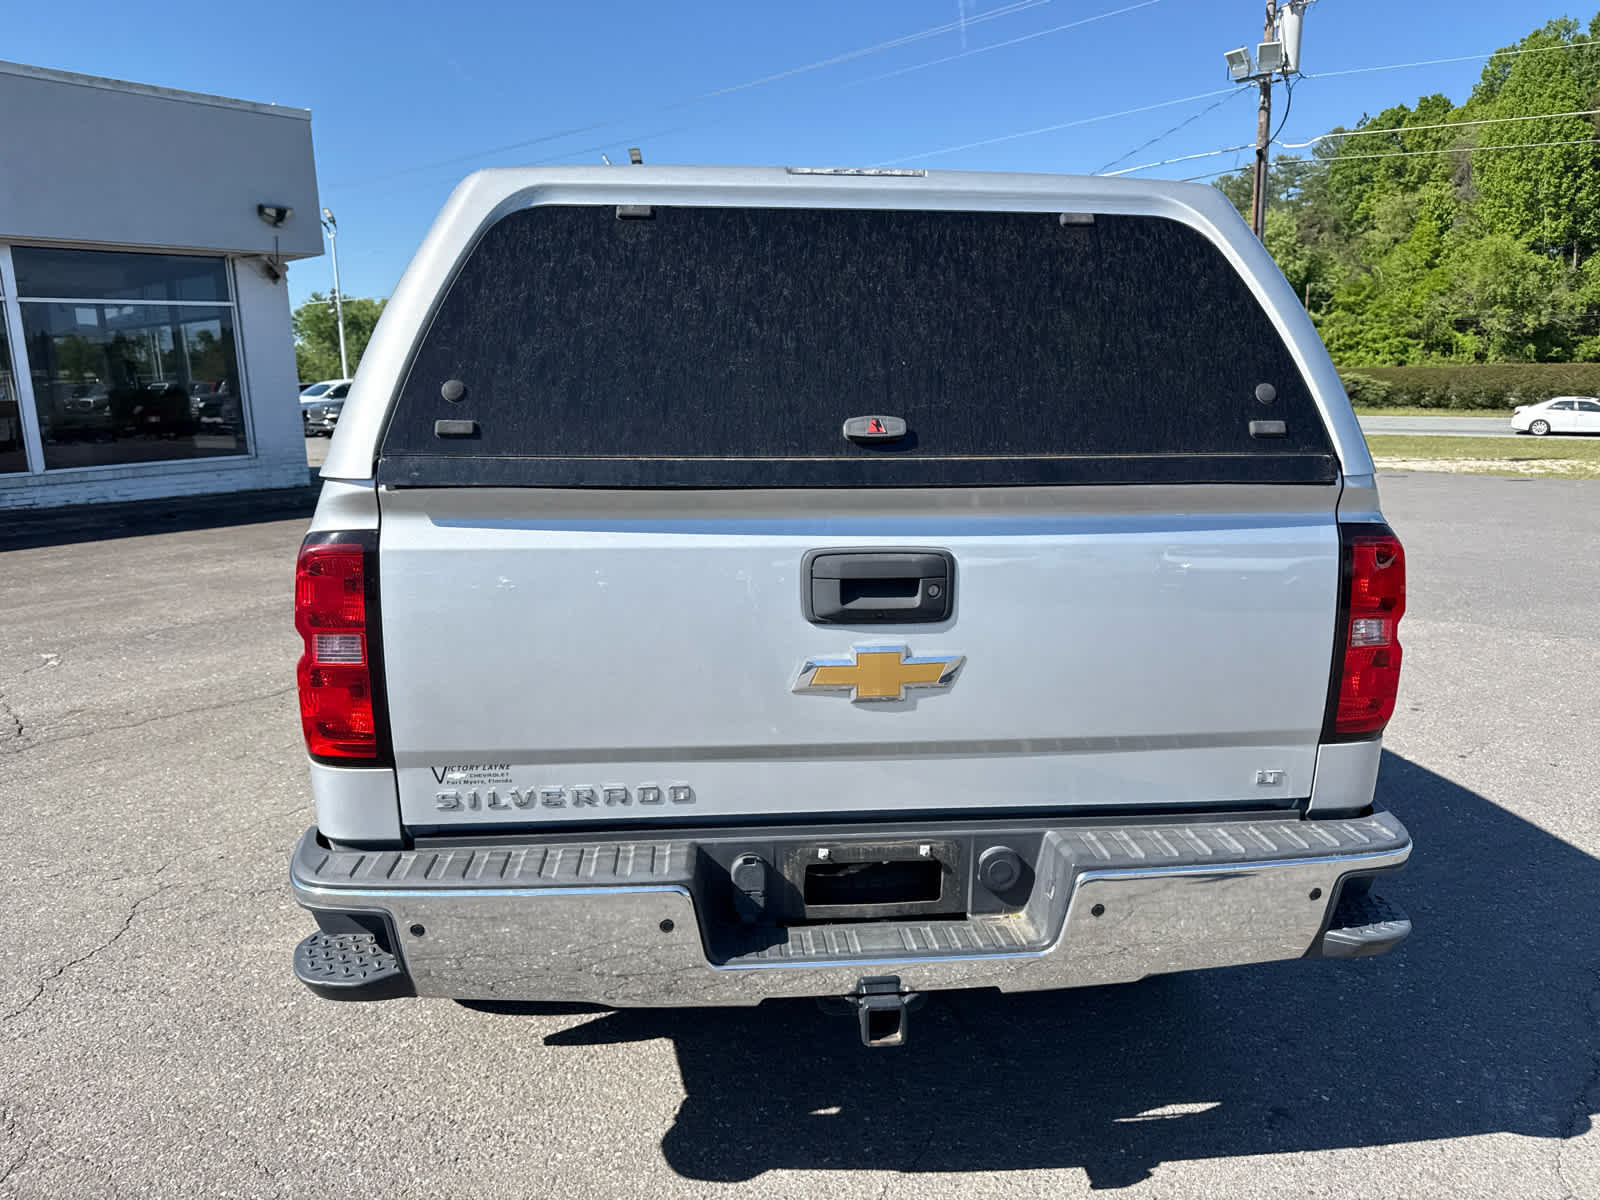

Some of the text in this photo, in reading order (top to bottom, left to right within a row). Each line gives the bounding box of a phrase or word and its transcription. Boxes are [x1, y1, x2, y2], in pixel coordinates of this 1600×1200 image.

[431, 763, 511, 784] VICTORY LAYNE
[1255, 769, 1284, 785] LT
[435, 783, 694, 811] SILVERADO
